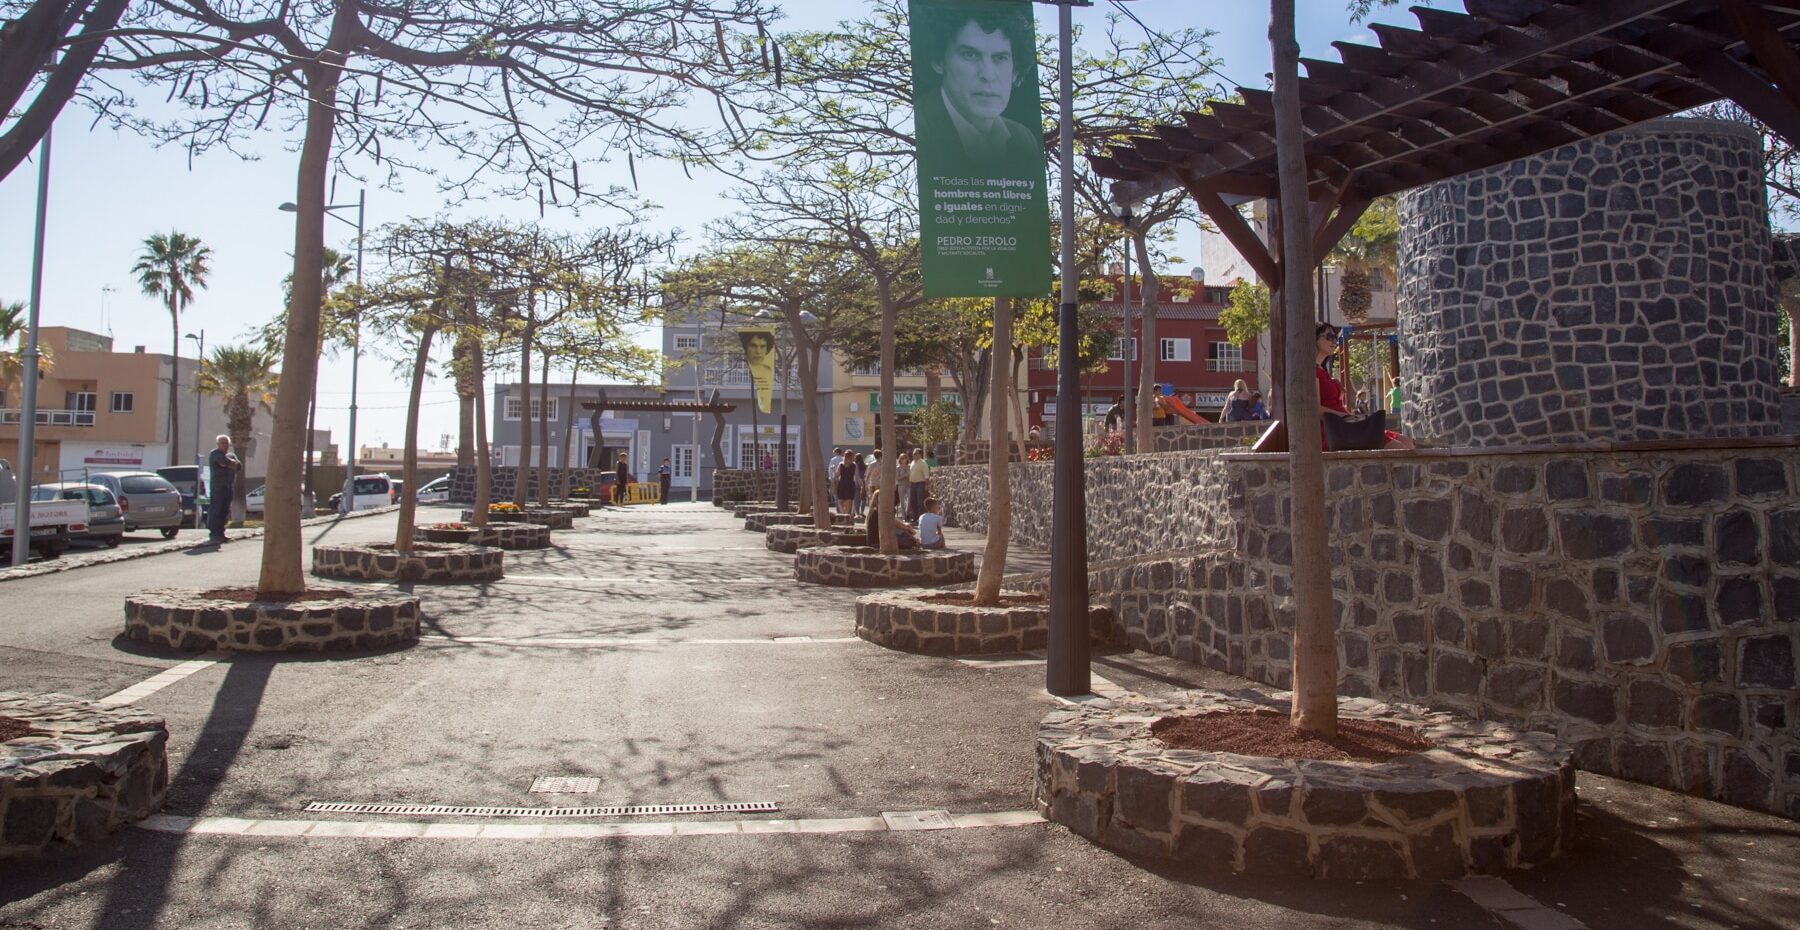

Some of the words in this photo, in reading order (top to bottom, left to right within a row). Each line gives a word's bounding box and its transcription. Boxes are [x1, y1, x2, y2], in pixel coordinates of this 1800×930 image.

[971, 176, 985, 187] las
[986, 178, 1028, 189] mujeres
[1028, 180, 1035, 190] y
[934, 189, 980, 199] hombres
[982, 191, 1001, 199] son
[1003, 190, 1032, 200] libres
[935, 203, 942, 211] e
[943, 202, 983, 213] iguales
[984, 203, 998, 212] en
[999, 202, 1026, 214] digni-
[935, 215, 955, 224] dad
[956, 217, 963, 226] y
[937, 236, 972, 246] PEDRO
[975, 236, 1017, 246] ZEROLO
[876, 393, 917, 405] CNICA
[922, 393, 961, 406] DTAL
